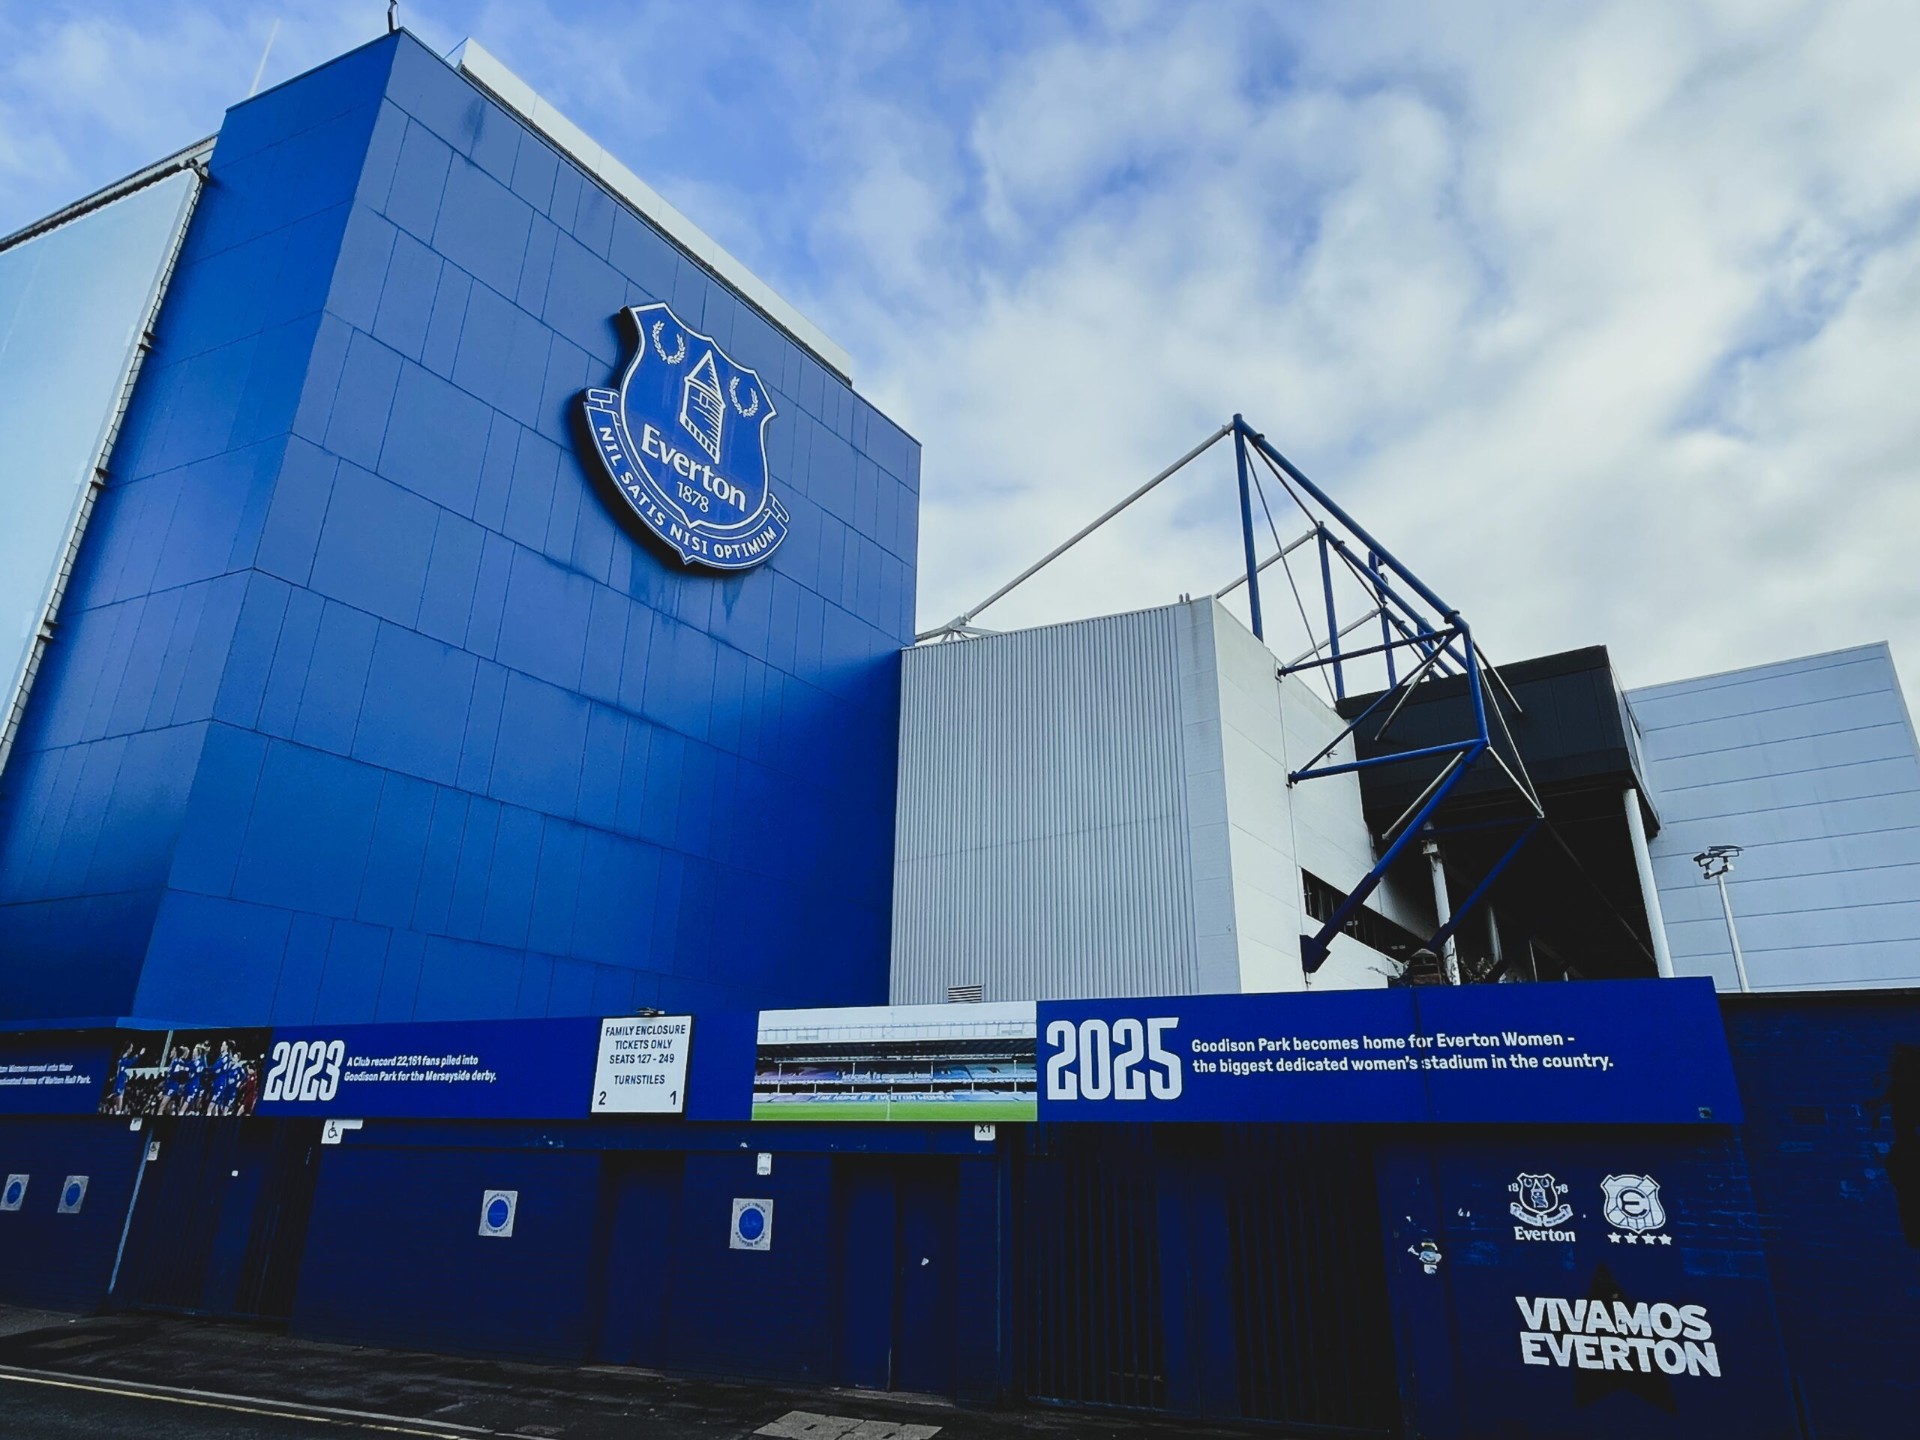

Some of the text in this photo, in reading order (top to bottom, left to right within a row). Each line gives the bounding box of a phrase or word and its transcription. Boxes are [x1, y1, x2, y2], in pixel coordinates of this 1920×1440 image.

[641, 424, 746, 512] Everton
[599, 426, 777, 559] NIL SATIS NISI OPTIMUM
[676, 482, 710, 513] 1878
[605, 1024, 686, 1036] FAMILY ENCLOSURE
[615, 1039, 673, 1050] TICKETS ONLY
[1191, 1038, 1255, 1053] Goodison
[1258, 1037, 1291, 1052] Park
[1293, 1036, 1359, 1051] becomes
[1363, 1036, 1406, 1050] home
[1408, 1034, 1434, 1048] for
[1436, 1033, 1500, 1048] Everton
[1502, 1032, 1564, 1048] Women
[346, 1056, 352, 1066] A
[353, 1056, 370, 1066] Club
[371, 1056, 397, 1066] record
[422, 1056, 440, 1066] fans
[440, 1054, 462, 1068] piled
[462, 1054, 478, 1065] into
[609, 1054, 636, 1064] SEATS
[636, 1054, 652, 1064] 127
[658, 1054, 675, 1064] 249
[1045, 1017, 1182, 1101] 2025
[1193, 1053, 1614, 1076] the biggest dedicated women's stadium in the country.
[263, 1040, 345, 1101] 2023
[344, 1070, 497, 1084] Goodison Park for the Merseyside derby.
[614, 1074, 666, 1085] TURNSTILES
[598, 1091, 607, 1106] 2
[670, 1090, 677, 1106] 1
[1508, 1182, 1520, 1192] 18
[1555, 1184, 1569, 1195] 78
[1513, 1226, 1576, 1242] Everton
[1515, 1296, 1713, 1341] VIVAMOS
[1519, 1331, 1722, 1378] EVERTON
